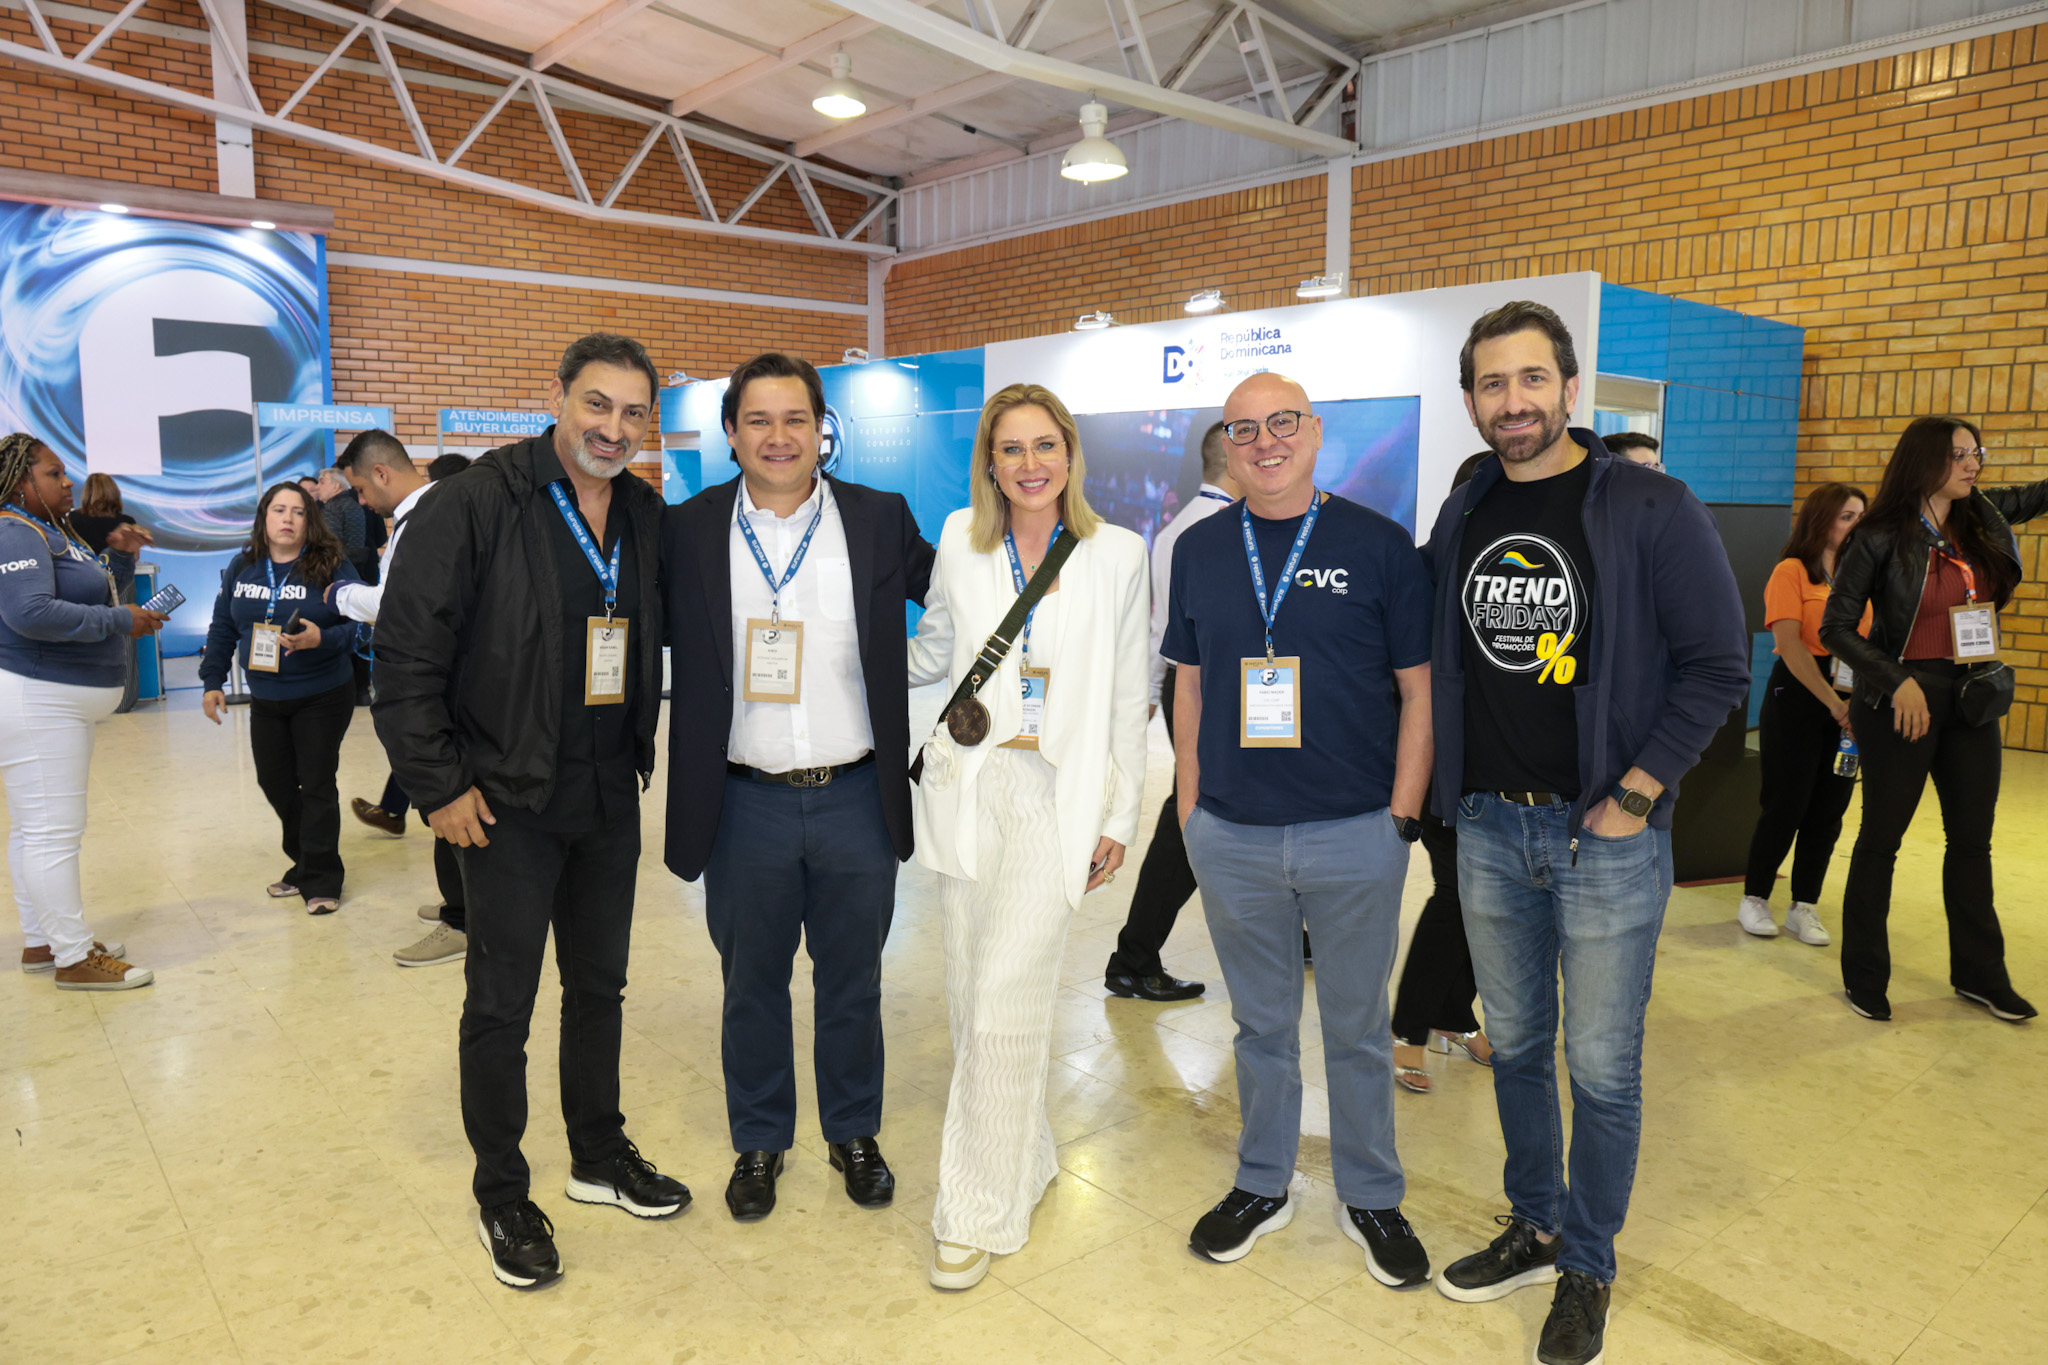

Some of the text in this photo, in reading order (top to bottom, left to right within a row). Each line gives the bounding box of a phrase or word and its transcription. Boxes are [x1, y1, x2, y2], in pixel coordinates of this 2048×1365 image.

[1220, 327, 1281, 346] República
[1220, 343, 1292, 360] Dominicana
[273, 407, 376, 425] IMPRENSA
[449, 410, 546, 424] ATENDIMENTO
[455, 422, 544, 435] BUYER LGBT+
[1295, 568, 1349, 588] CVC
[1331, 588, 1348, 596] corp
[1473, 575, 1568, 606] TREND
[1471, 603, 1569, 630] FRIDAY
[1495, 635, 1523, 643] FESTIVAL
[1536, 632, 1577, 685] %
